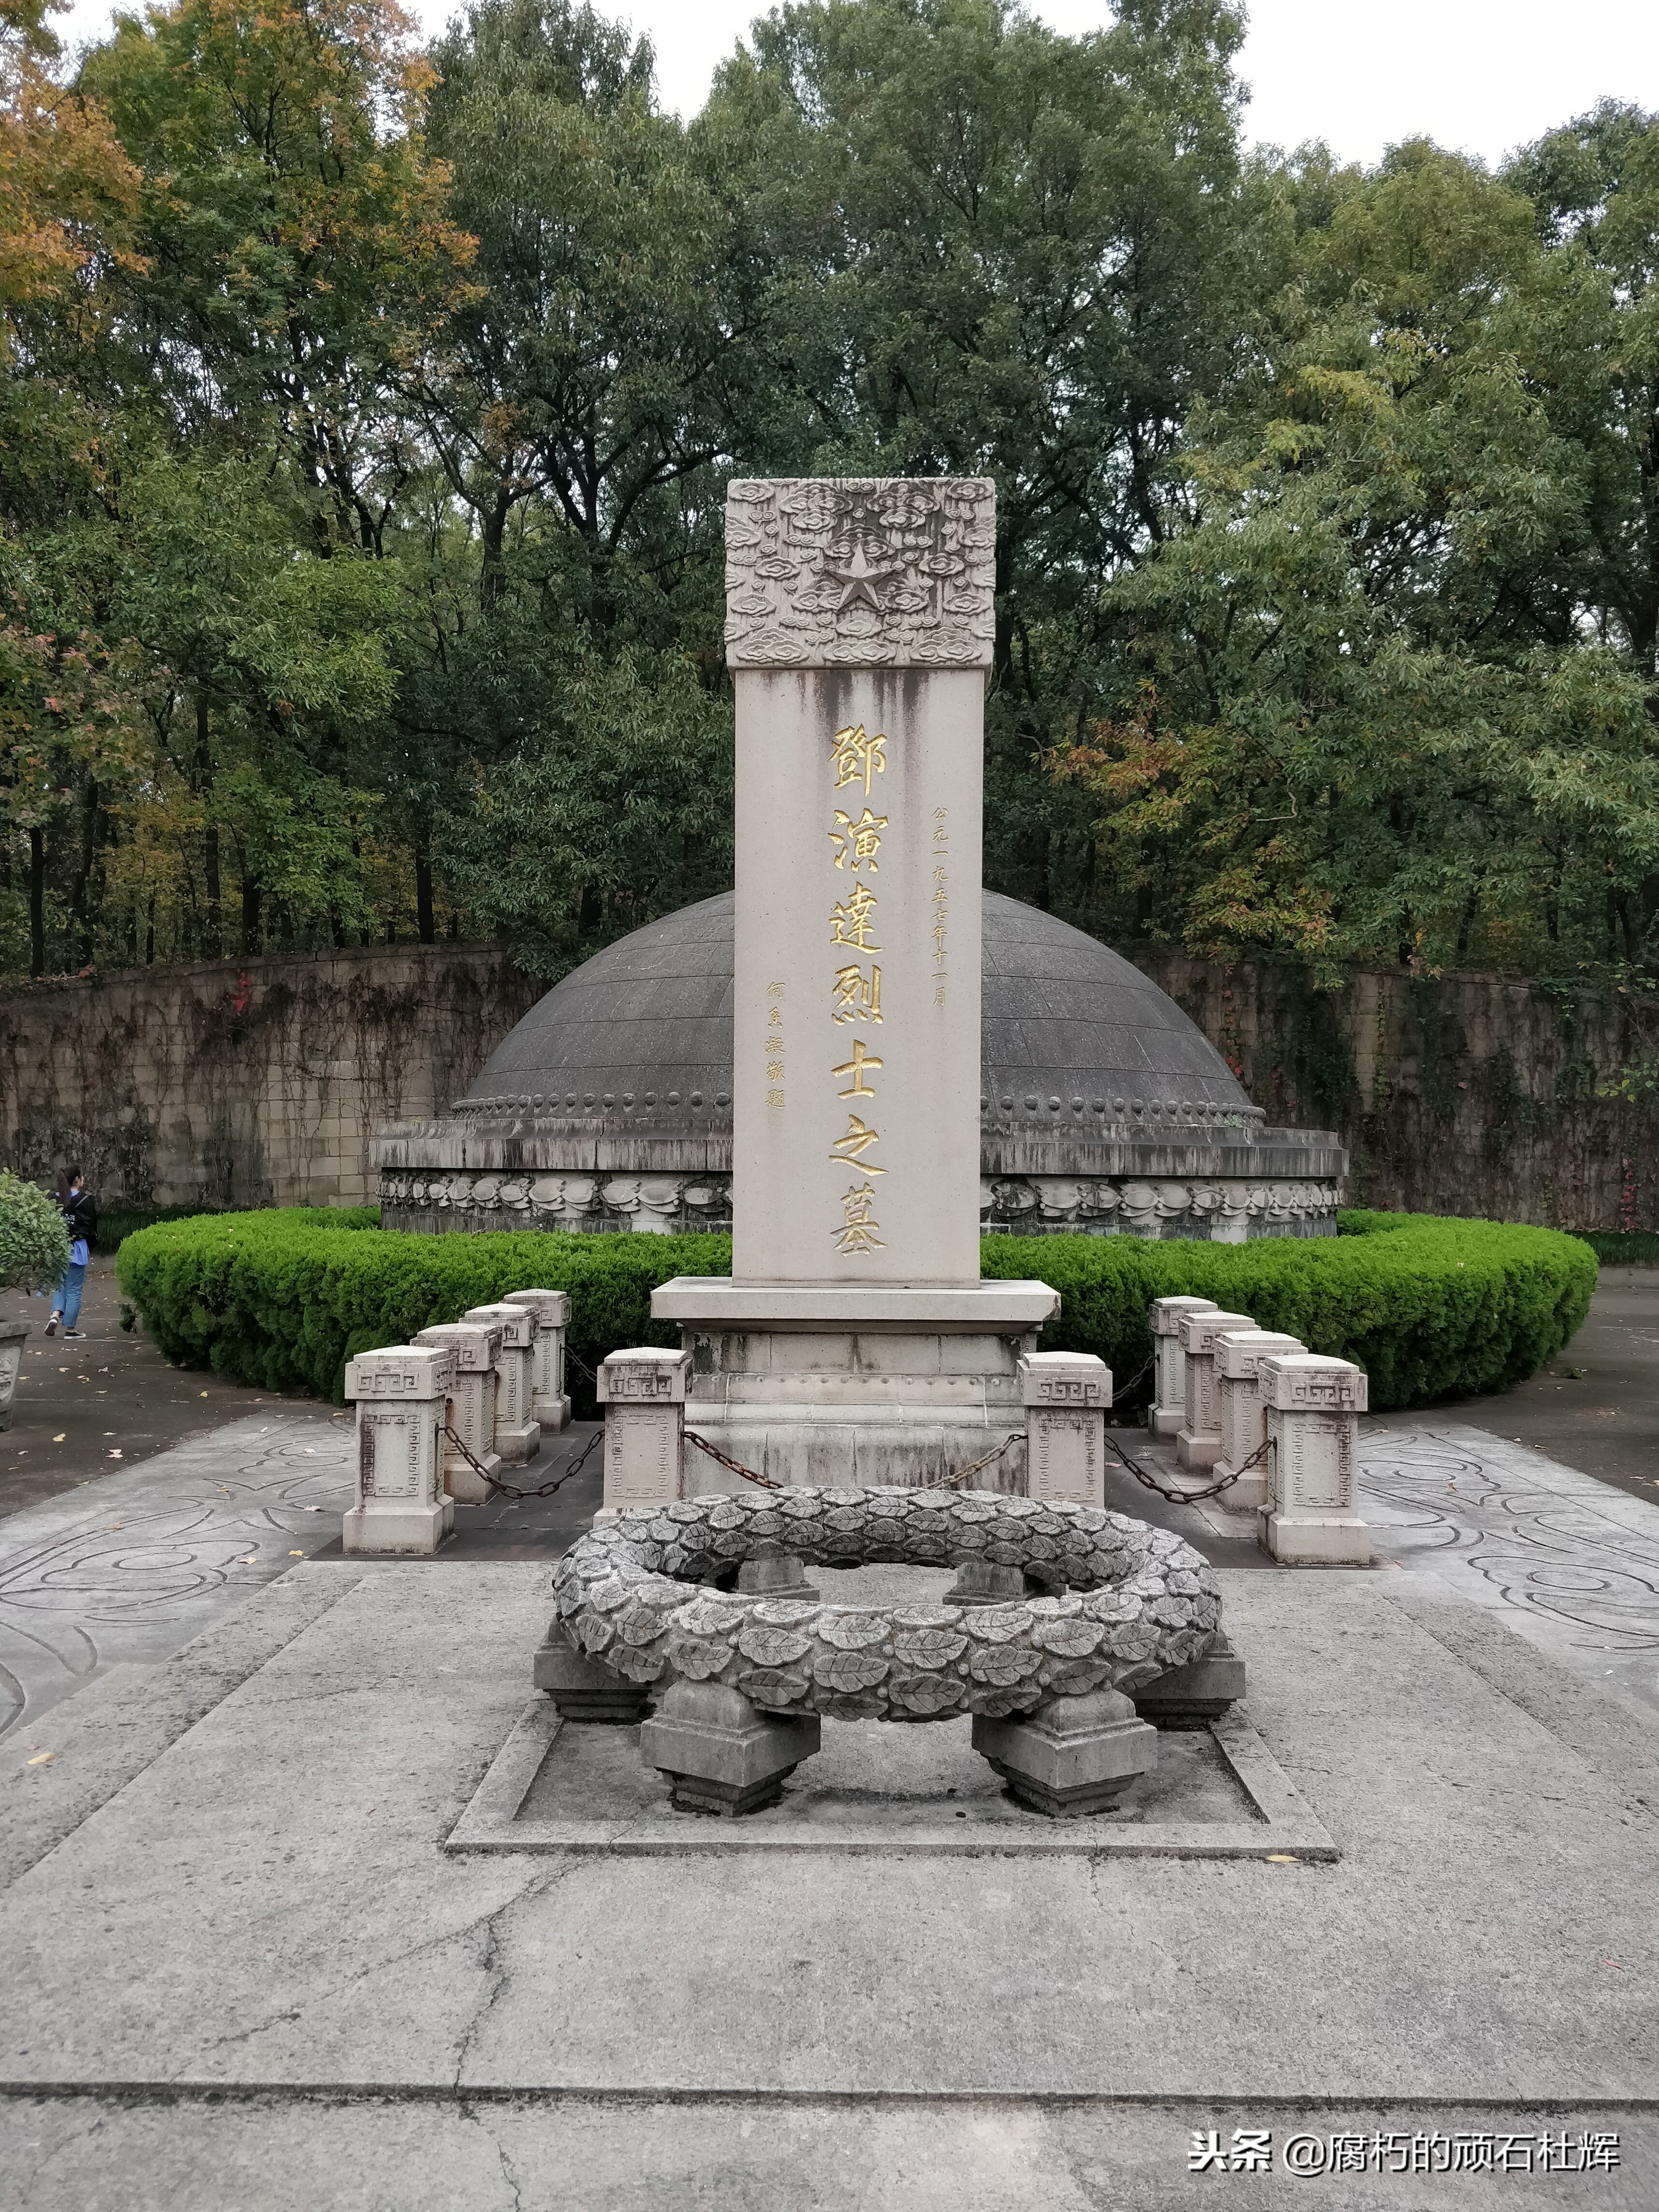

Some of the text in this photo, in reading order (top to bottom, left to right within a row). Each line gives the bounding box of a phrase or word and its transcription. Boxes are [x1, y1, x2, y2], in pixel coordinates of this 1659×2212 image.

[827, 723, 889, 1257] 鄧演達烈士之墓
[931, 807, 949, 1007] 公元一九五七年十一月
